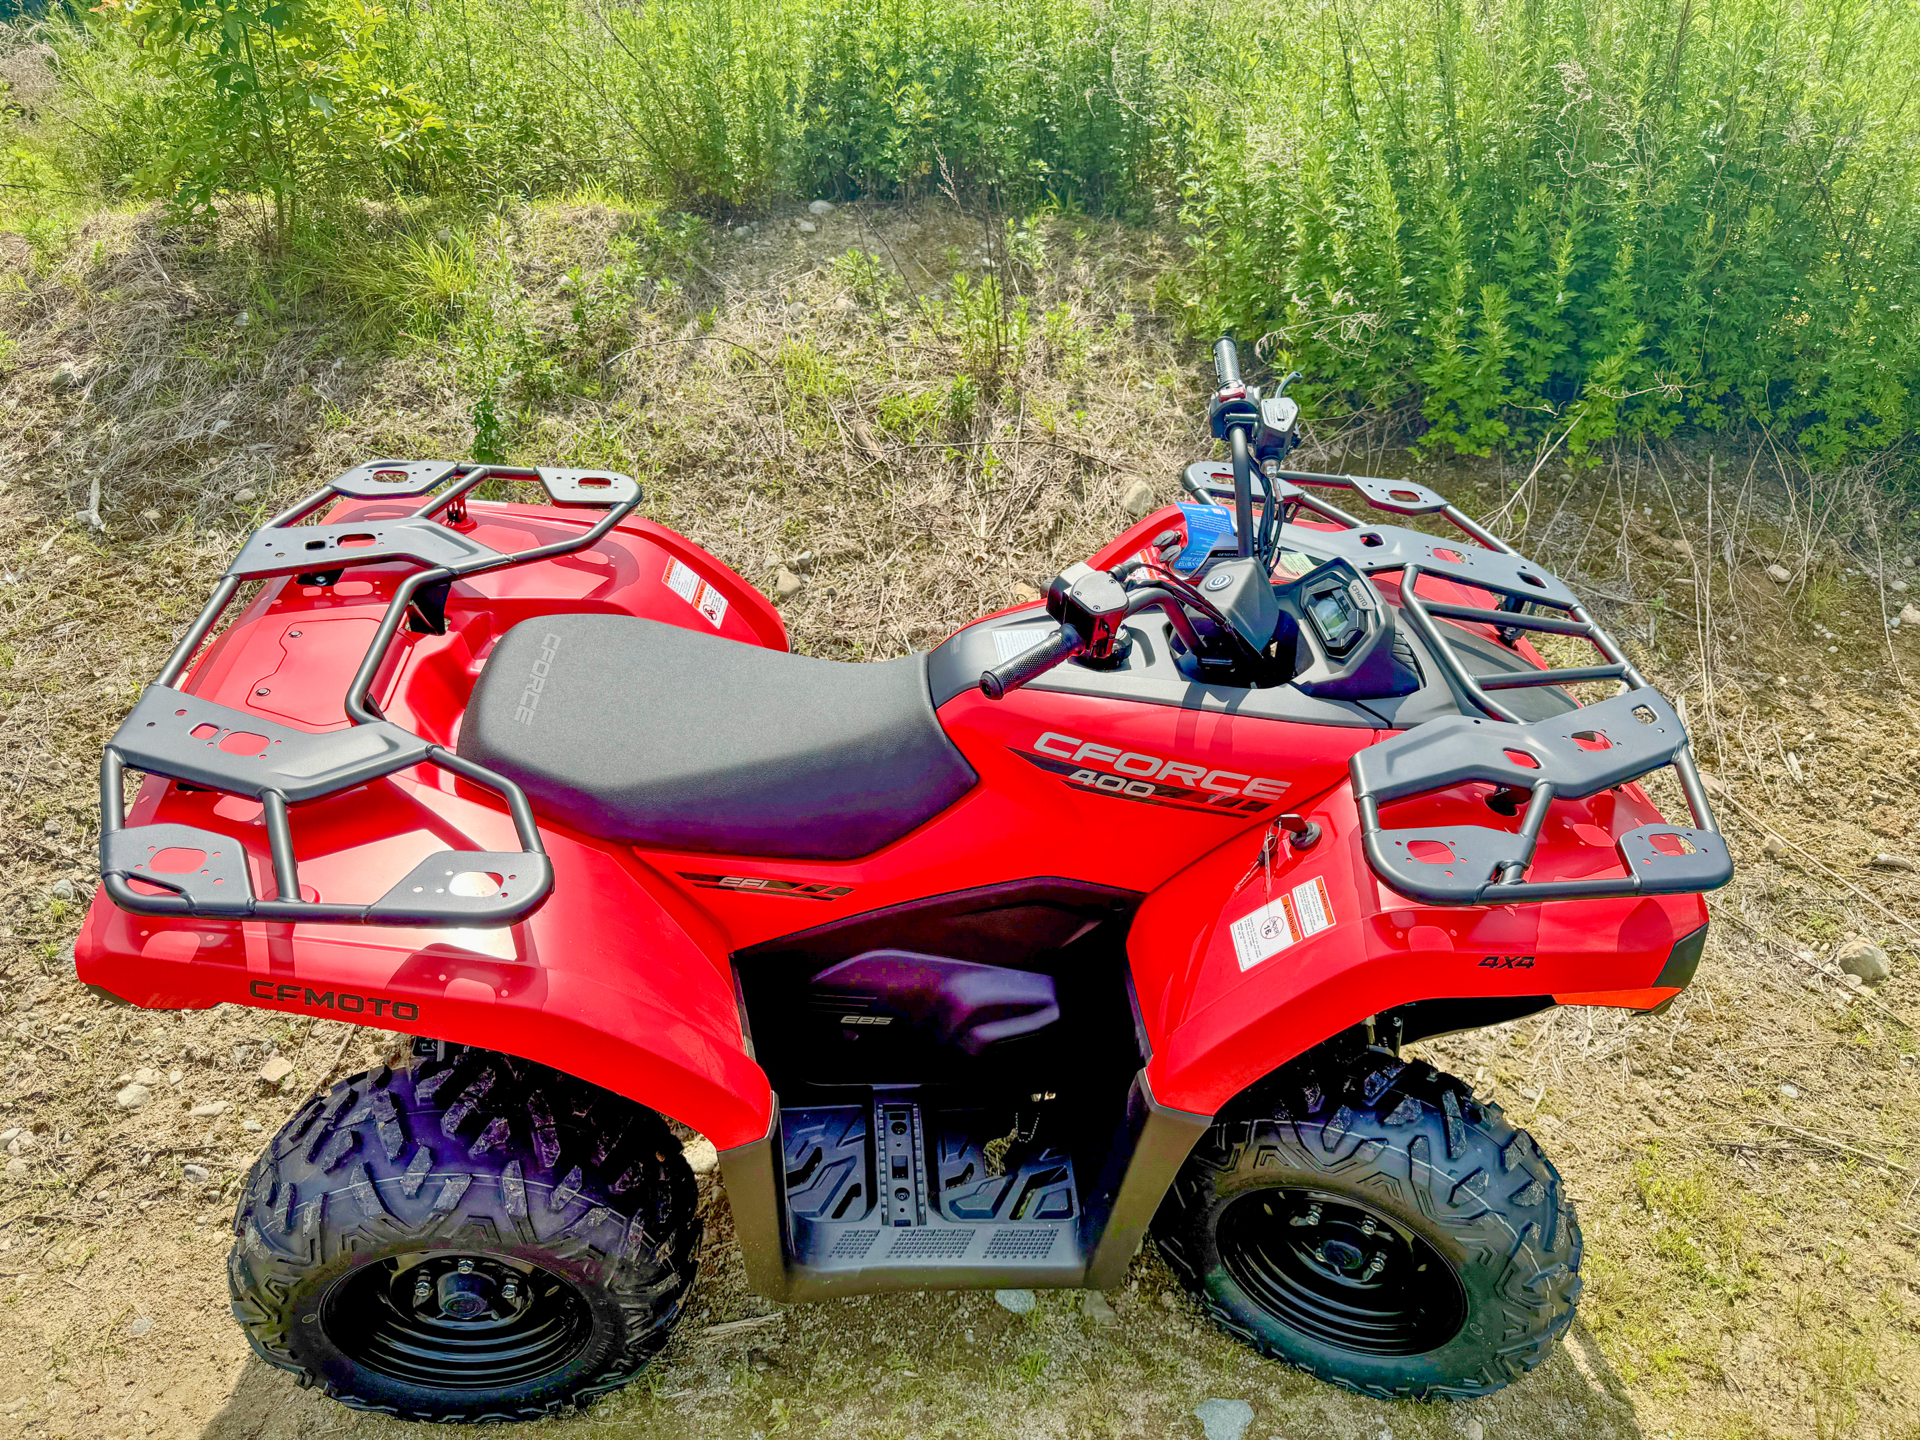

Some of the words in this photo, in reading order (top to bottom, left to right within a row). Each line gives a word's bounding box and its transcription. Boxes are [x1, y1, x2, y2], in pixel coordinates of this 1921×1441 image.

[1351, 584, 1368, 607] CFMOTO
[514, 632, 562, 727] CFORCE
[1033, 731, 1293, 801] CFORCE
[1068, 769, 1156, 798] 400
[718, 876, 770, 889] EFI
[1263, 924, 1272, 936] 16
[1285, 908, 1297, 934] WARNING
[1477, 956, 1536, 969] 4X4
[248, 979, 420, 1021] CFMOTO
[840, 1015, 894, 1025] EBS
